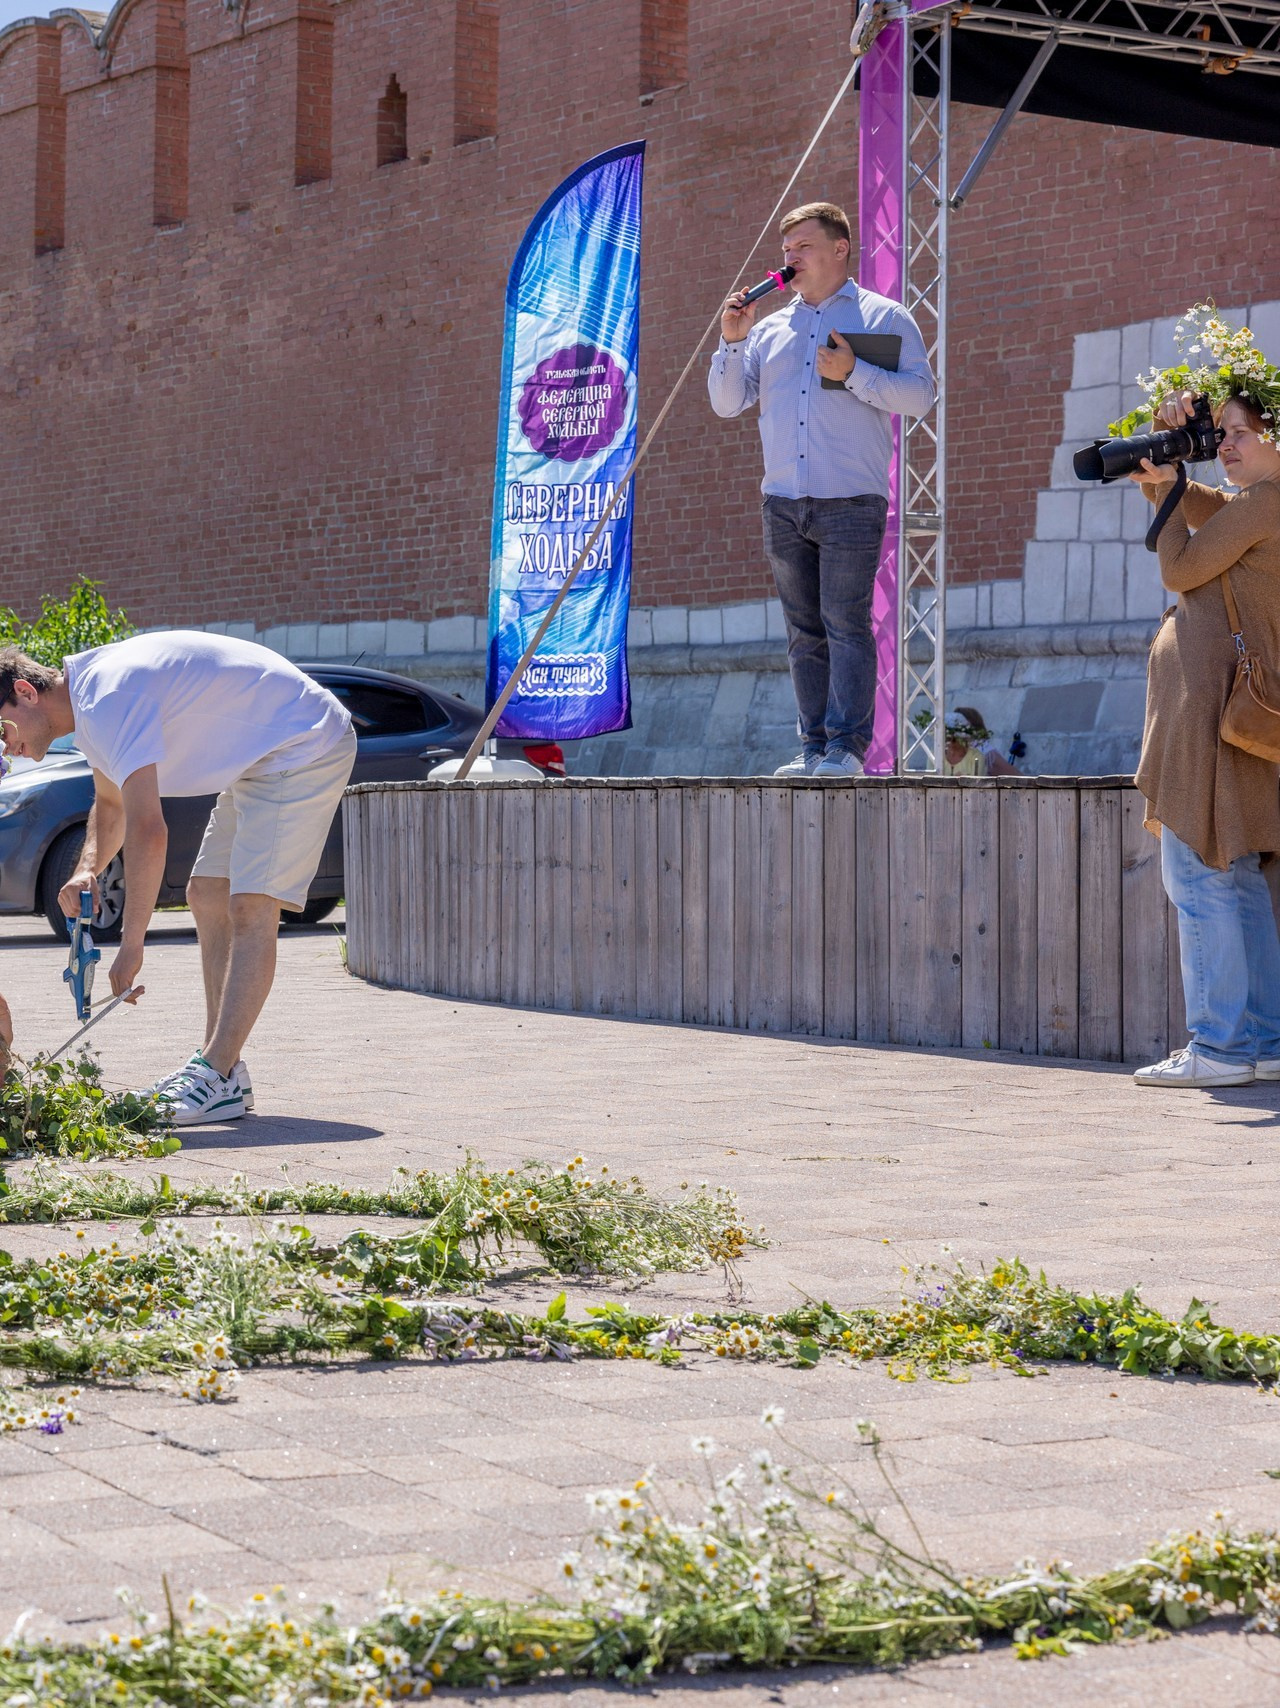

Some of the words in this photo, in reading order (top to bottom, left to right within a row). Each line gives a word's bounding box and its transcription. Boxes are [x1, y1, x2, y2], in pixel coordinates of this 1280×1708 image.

[537, 384, 612, 407] ФЕДЕРАЦИЯ
[542, 400, 605, 423] СЕВЕРНОЙ
[547, 420, 599, 439] ХОДЬБЫ
[519, 531, 612, 579] ХОДЬБА
